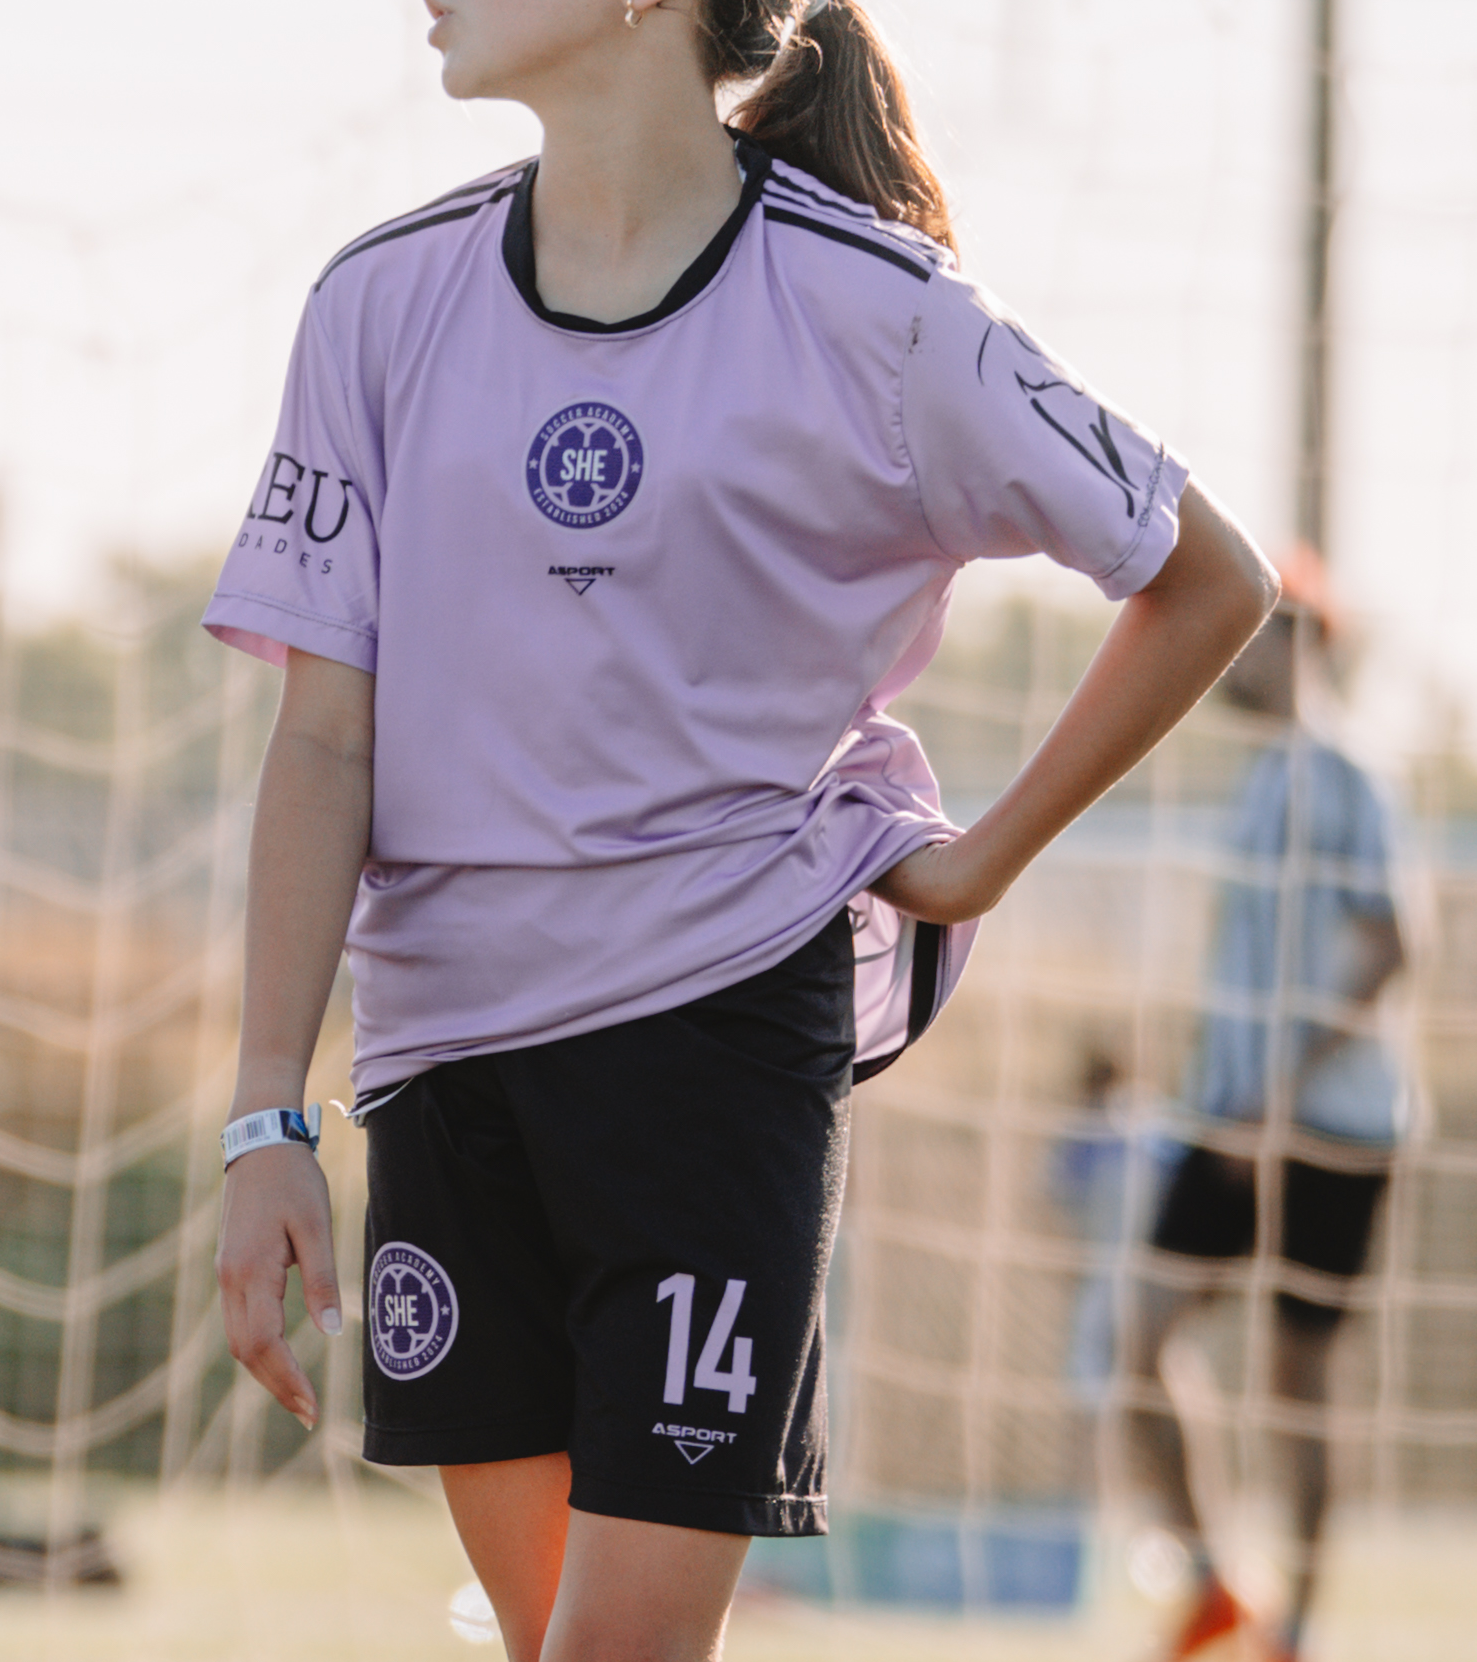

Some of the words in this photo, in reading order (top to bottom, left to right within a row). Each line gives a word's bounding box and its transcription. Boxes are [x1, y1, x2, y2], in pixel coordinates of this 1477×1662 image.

[587, 407, 634, 441] ACADEMY
[560, 449, 607, 481] SHE
[247, 452, 353, 543] EU
[533, 487, 601, 524] ESTABLISHED
[548, 566, 616, 576] ASPORT
[395, 1252, 441, 1285] ACADEMY
[385, 1294, 419, 1326] SHE
[656, 1272, 757, 1413] 14
[652, 1422, 737, 1444] ASPORT
